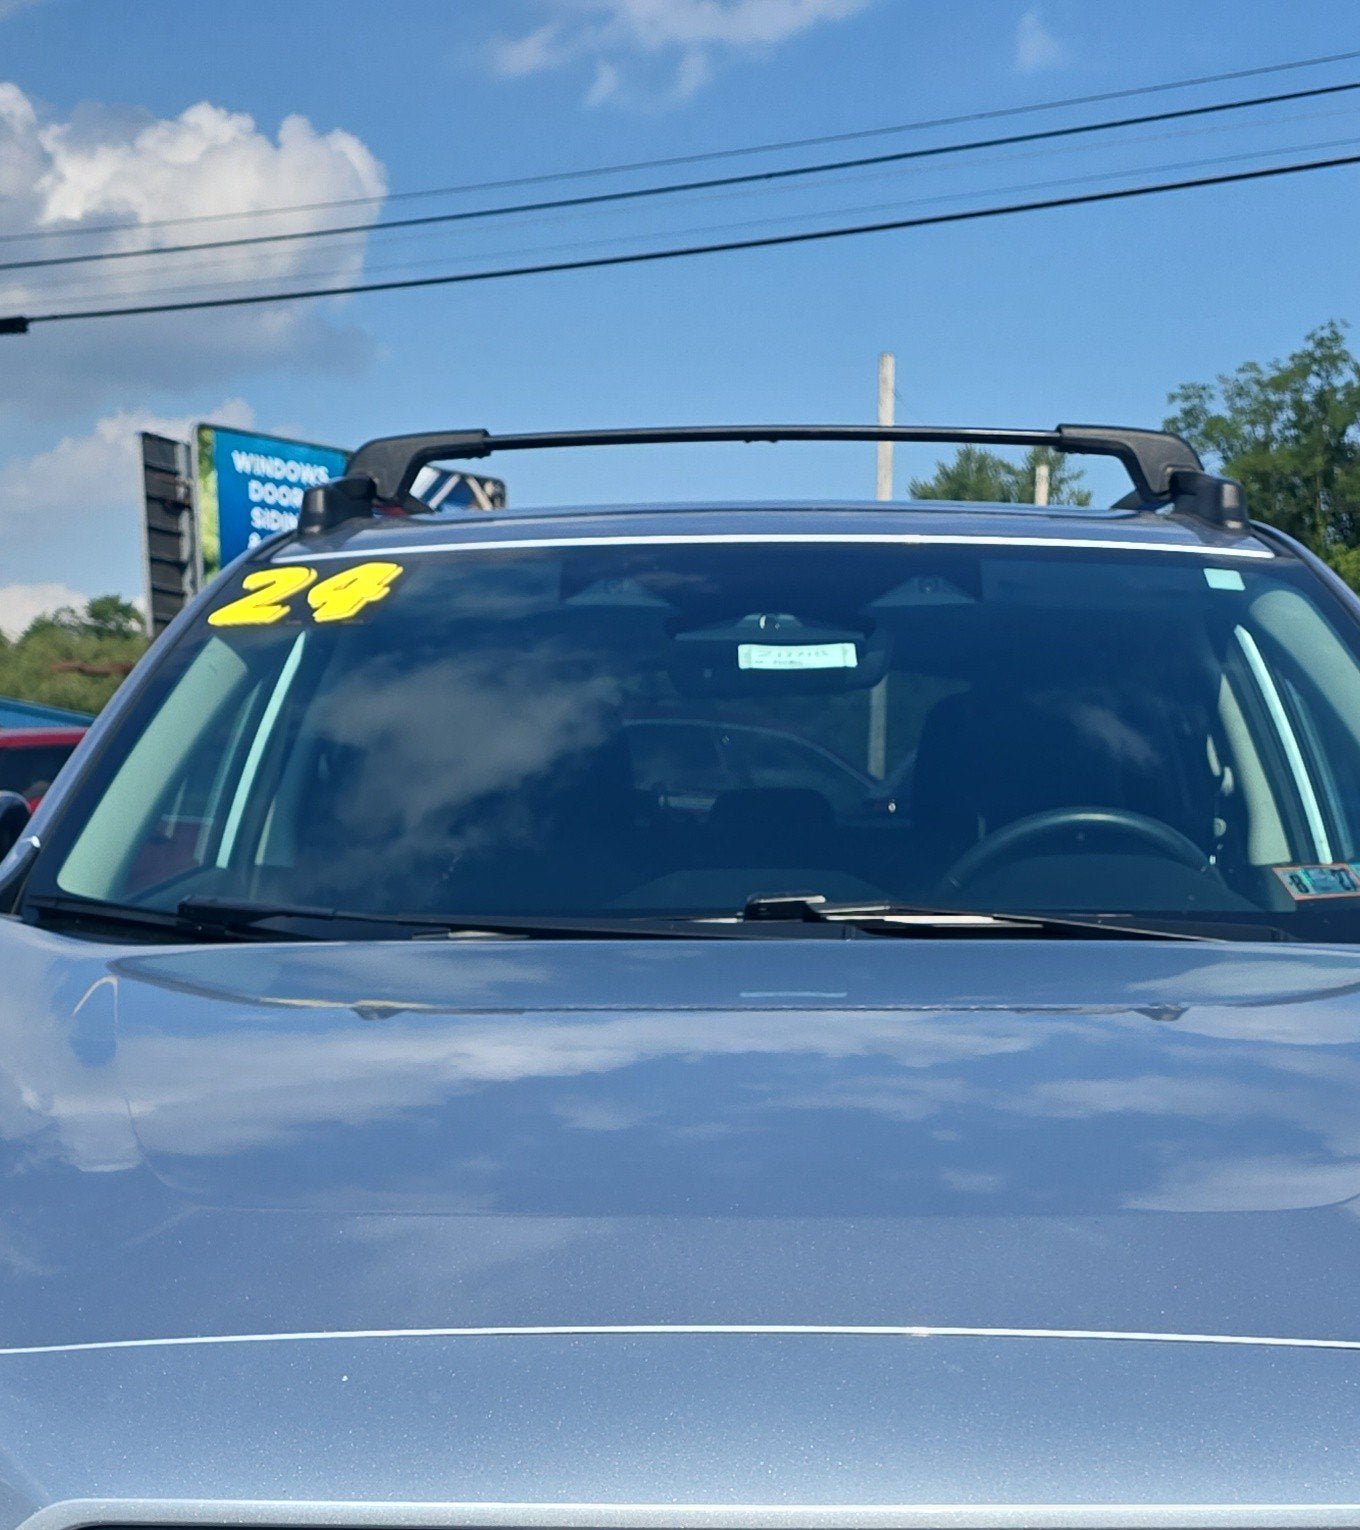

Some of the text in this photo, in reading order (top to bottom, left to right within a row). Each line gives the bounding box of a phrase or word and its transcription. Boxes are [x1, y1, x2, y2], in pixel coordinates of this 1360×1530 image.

[231, 449, 330, 487] WINDOWS
[248, 479, 304, 508] DOOR
[250, 506, 299, 533] SIDIN
[207, 562, 403, 626] 24
